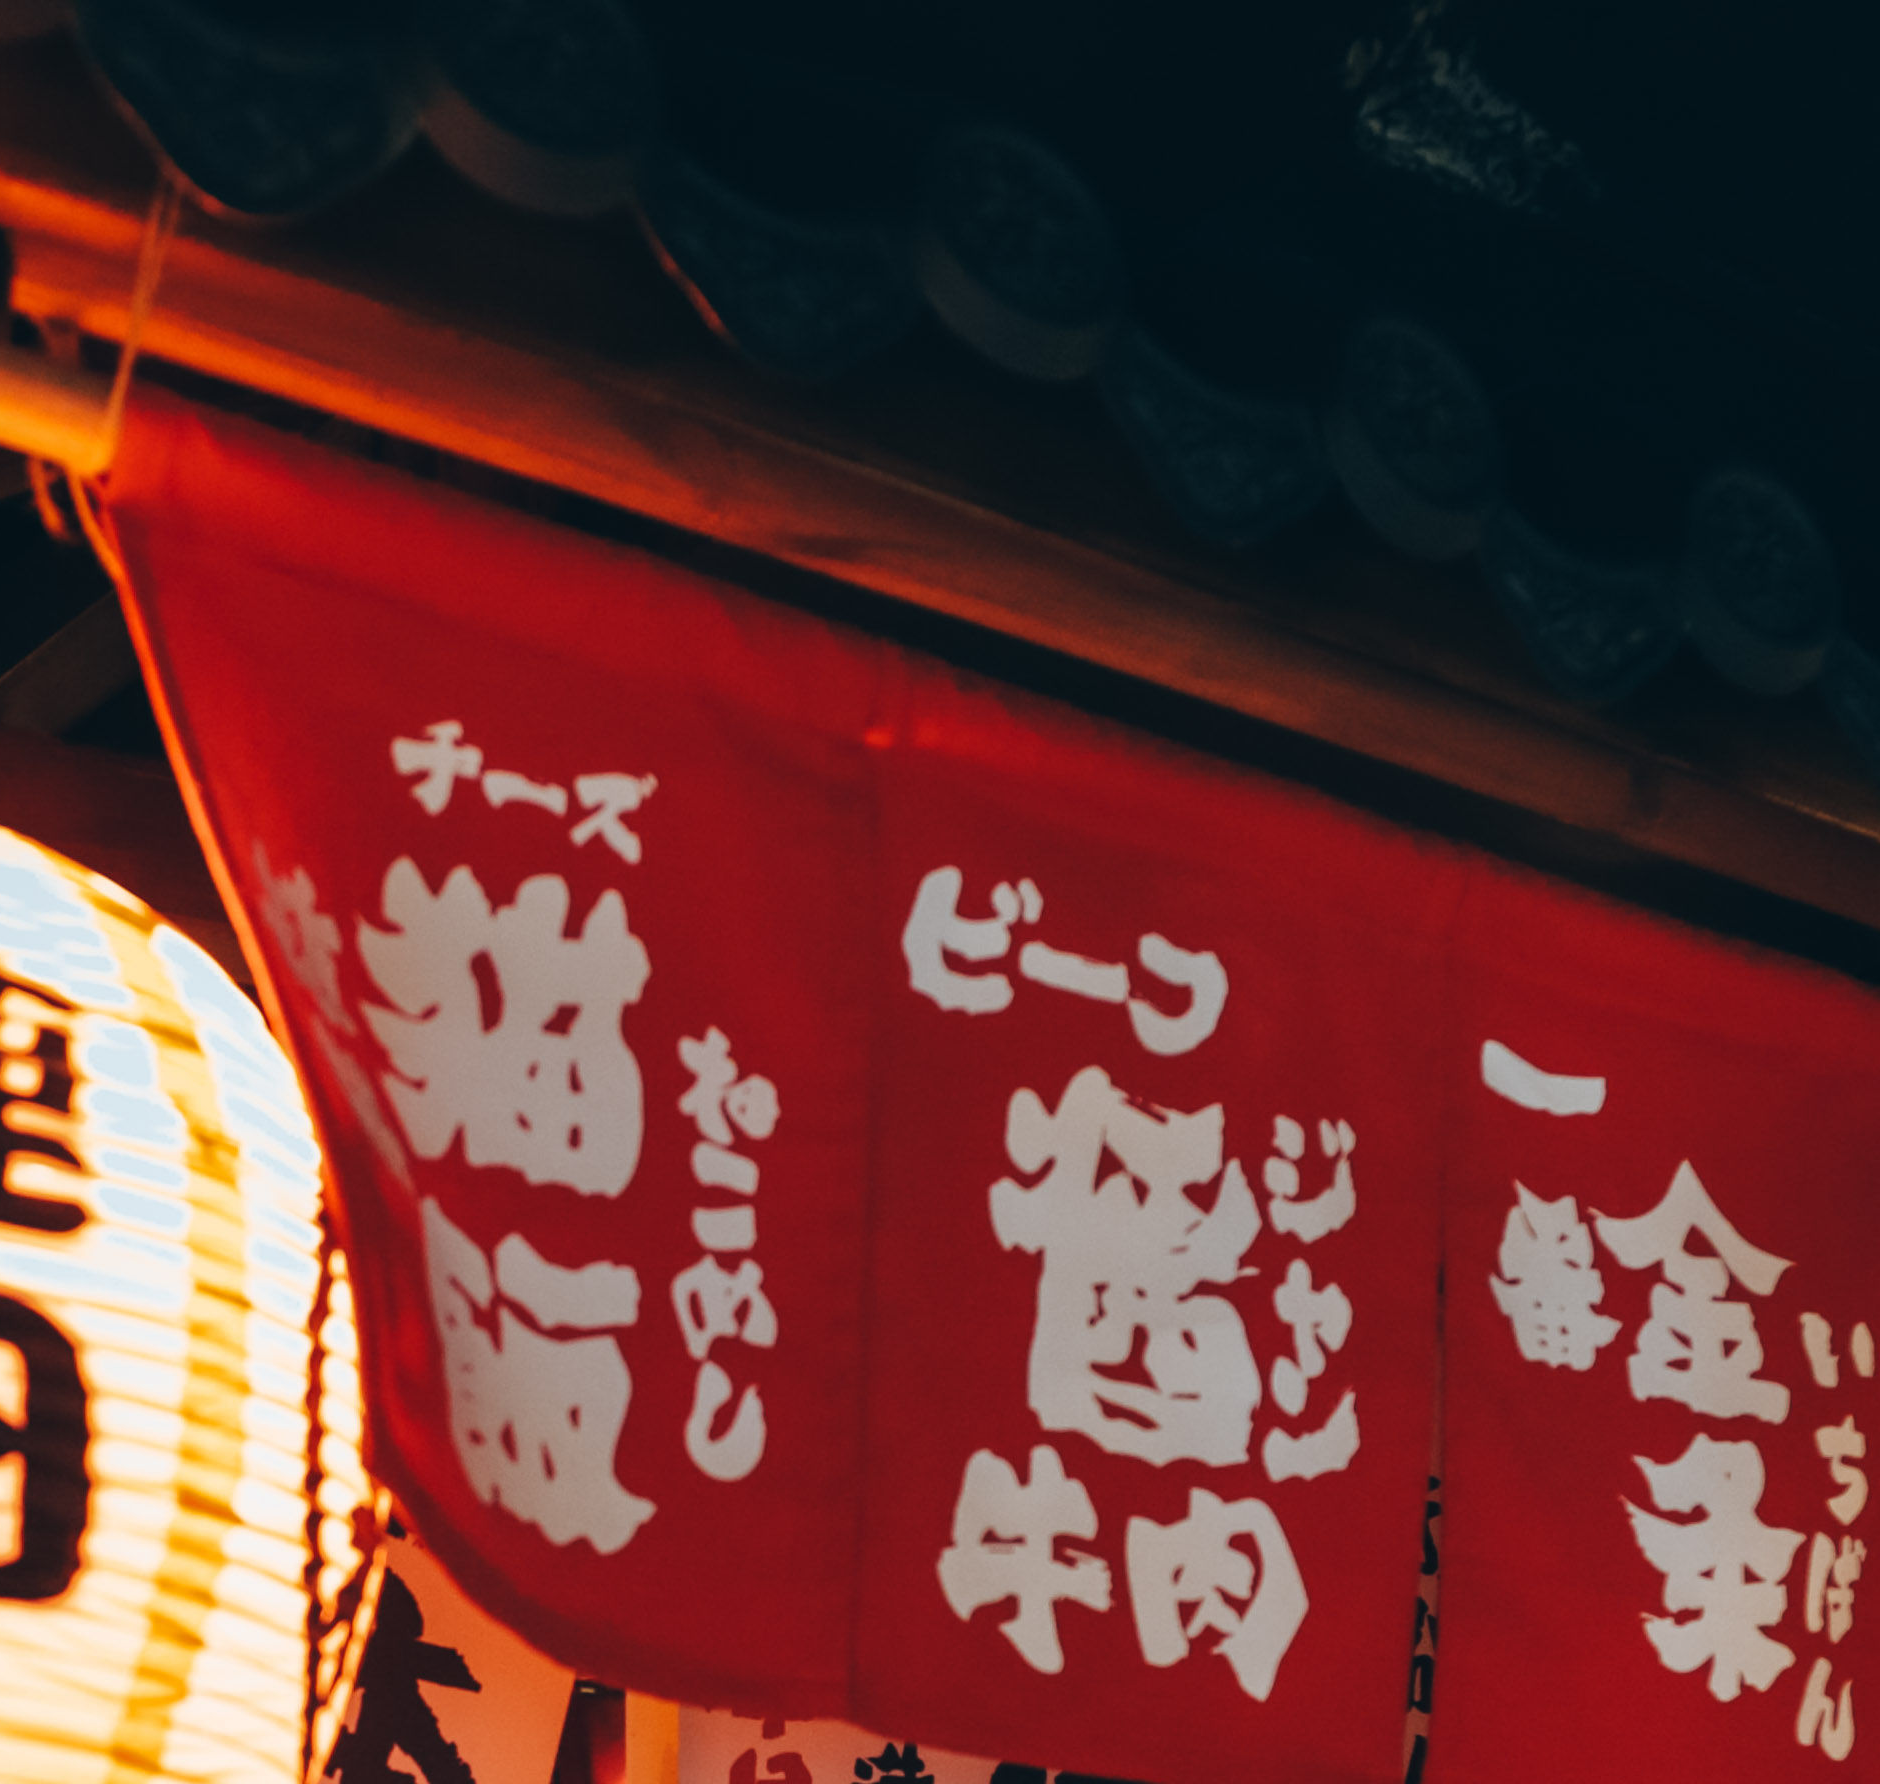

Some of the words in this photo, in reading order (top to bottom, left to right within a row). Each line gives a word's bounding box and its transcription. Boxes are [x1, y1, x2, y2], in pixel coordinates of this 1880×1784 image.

[391, 720, 658, 863] チーズ
[1793, 1312, 1876, 1762] いちばん
